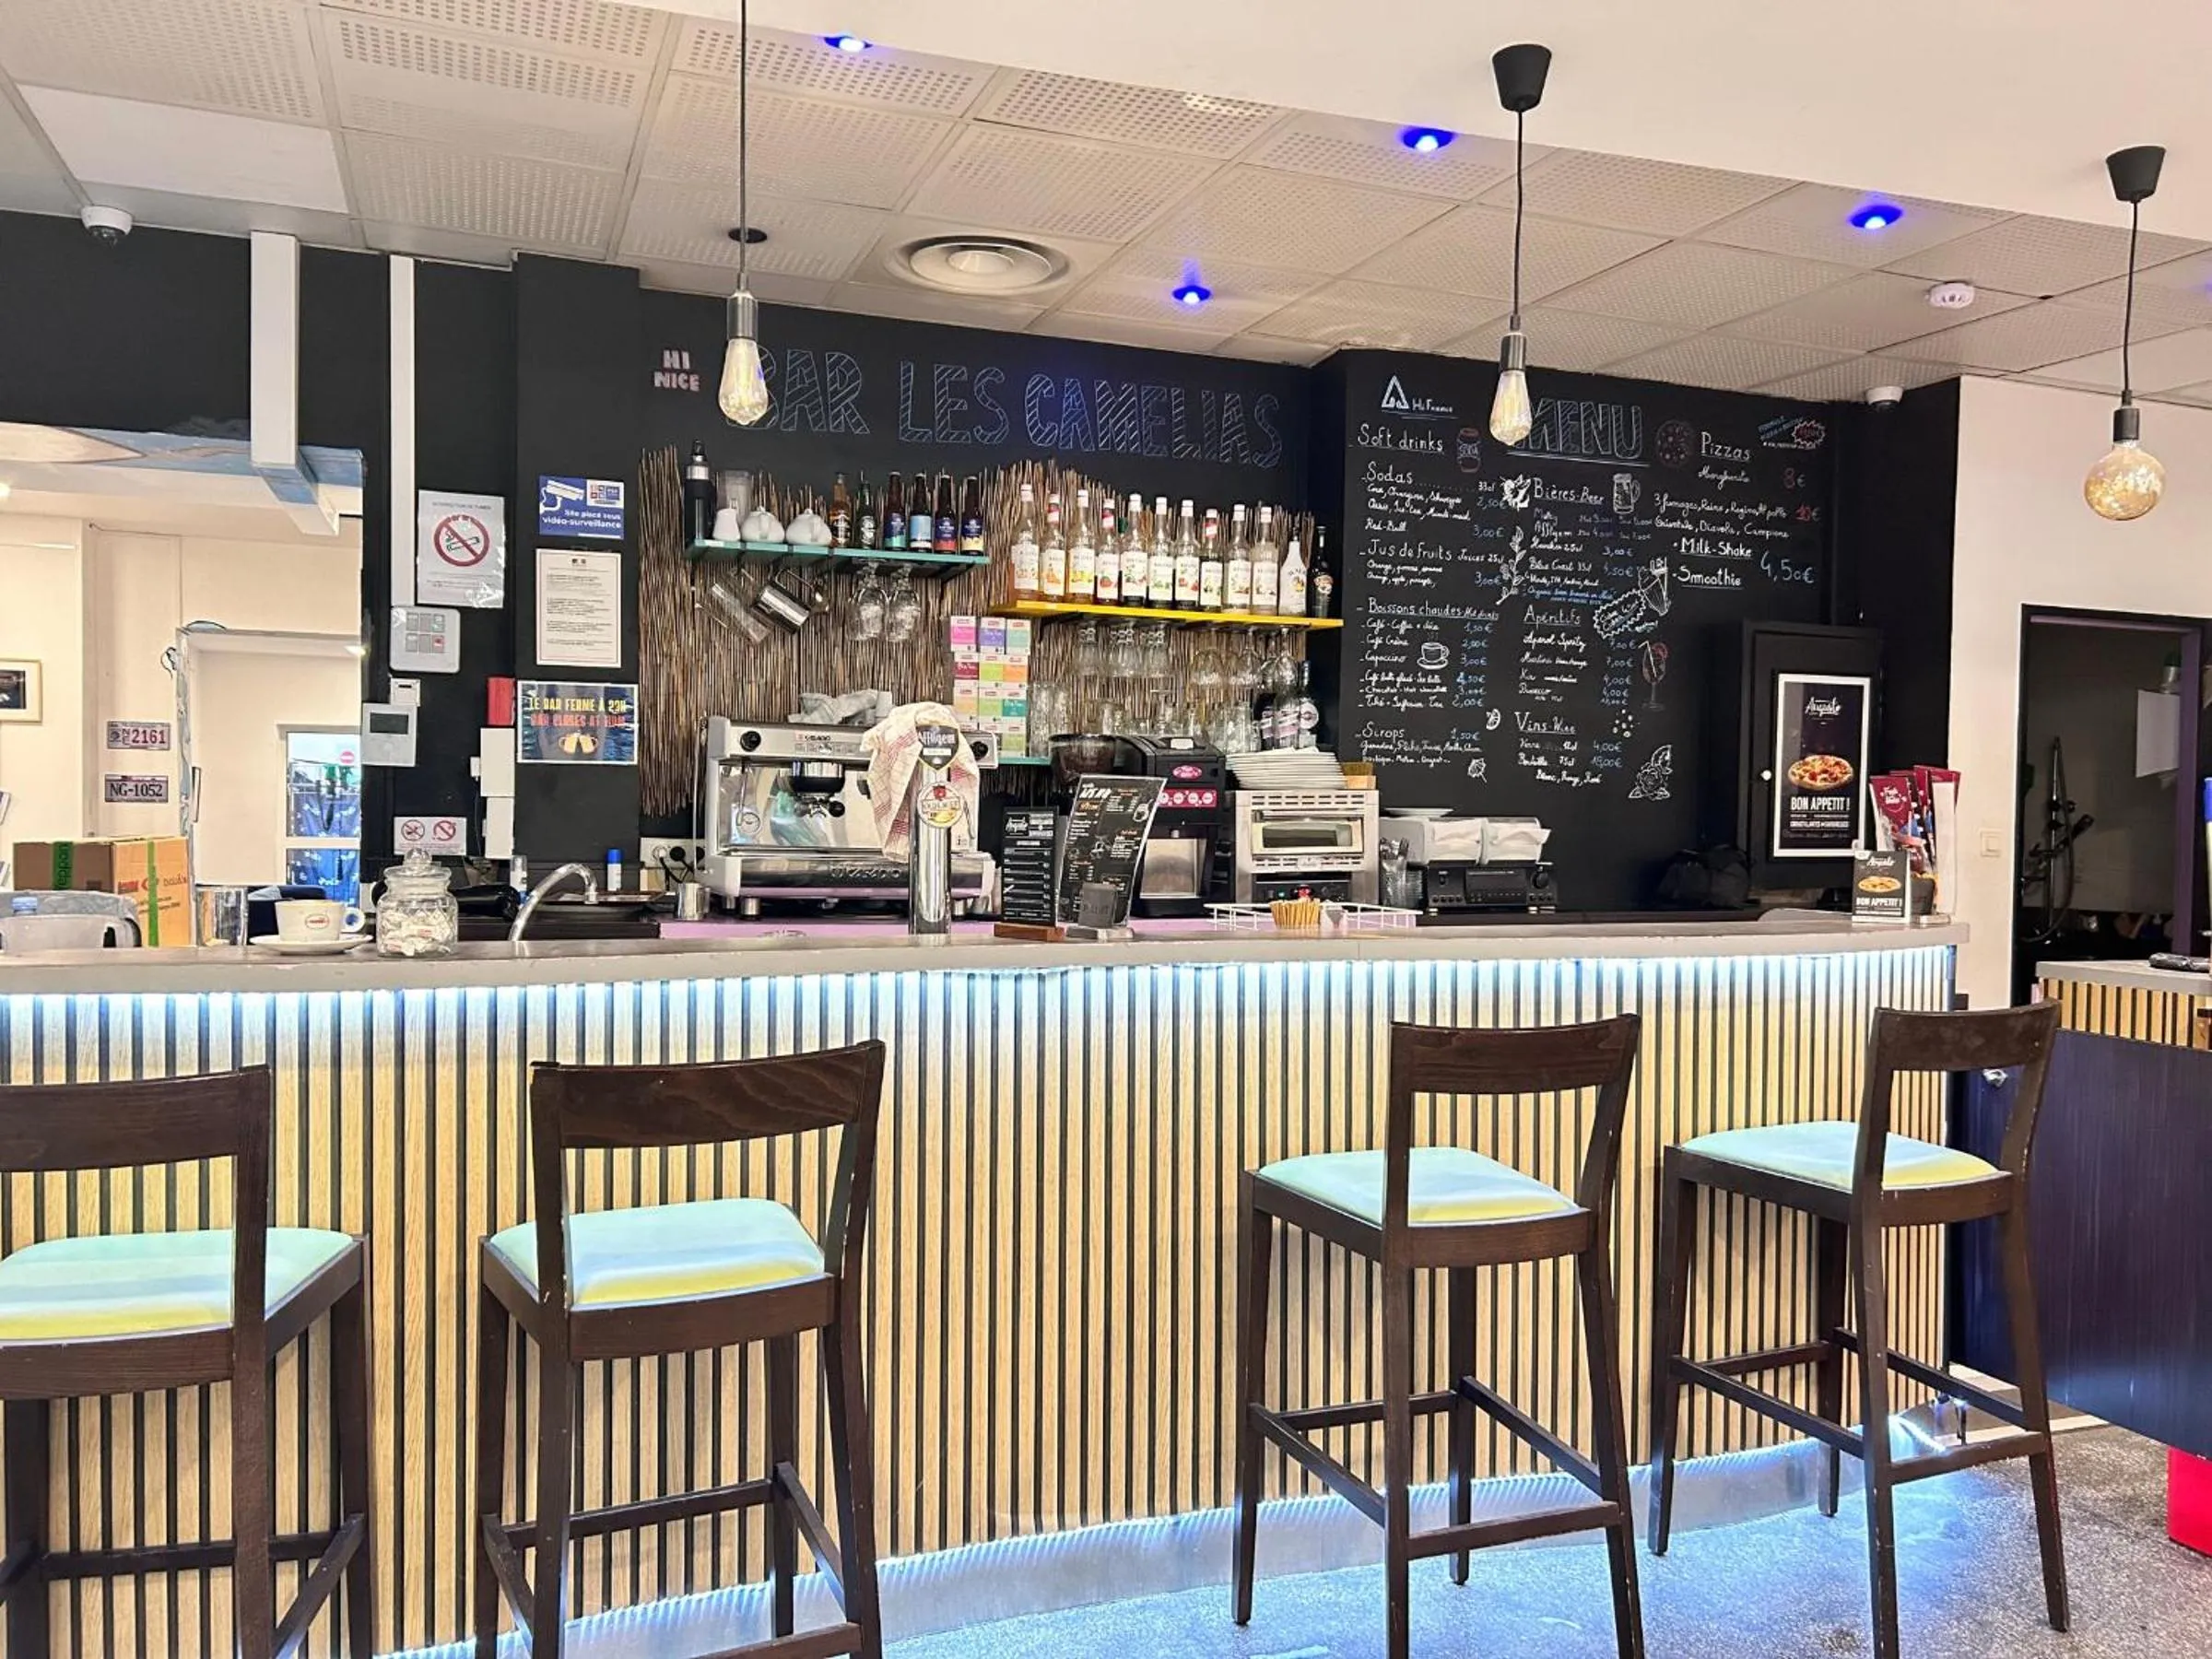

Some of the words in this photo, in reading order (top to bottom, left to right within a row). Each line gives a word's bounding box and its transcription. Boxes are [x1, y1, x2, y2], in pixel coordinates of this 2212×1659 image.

[663, 349, 690, 370] HI
[653, 371, 700, 392] NICE
[900, 360, 1010, 444] LES
[1024, 372, 1283, 469] CAMELIAS
[1358, 423, 1392, 448] Soft
[1398, 429, 1444, 453] drinks
[1515, 397, 1642, 460] MENU
[1701, 431, 1751, 460] Pizzas
[1366, 461, 1414, 485] Sodas
[542, 516, 622, 528] vidéo-surveillance
[1368, 538, 1395, 557] Jus
[1398, 542, 1414, 557] de
[1679, 536, 1752, 558] Milk-Shake
[1677, 565, 1742, 586] Smoothie
[1759, 550, 1814, 584] 4,50€
[1369, 597, 1415, 615] Boissons
[530, 697, 540, 710] LE
[543, 698, 561, 710] BAR
[566, 699, 595, 712] FERME
[132, 728, 166, 745] 2161
[1362, 722, 1406, 744] Sirops
[110, 782, 163, 797] NG-1052
[1791, 796, 1808, 811] BON
[1810, 796, 1845, 811] APPETIT
[1856, 897, 1870, 907] BON
[1871, 897, 1898, 908] APPETIT
